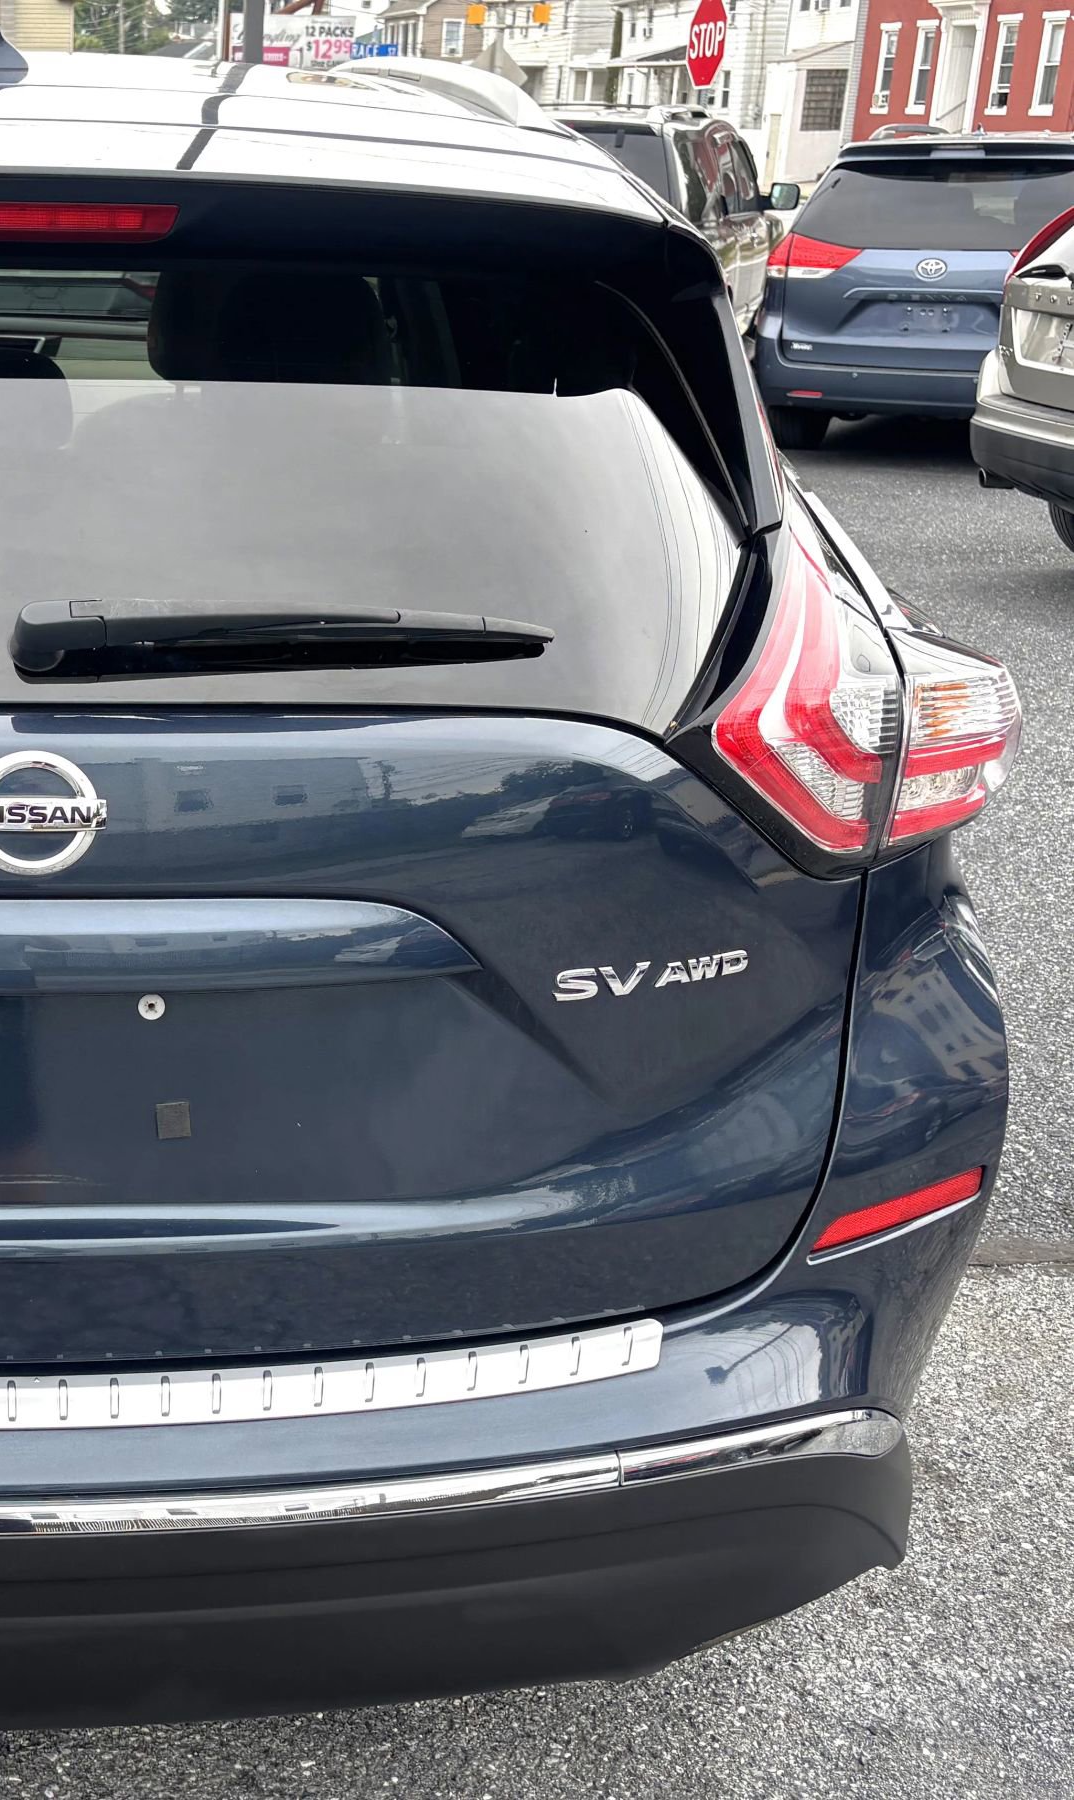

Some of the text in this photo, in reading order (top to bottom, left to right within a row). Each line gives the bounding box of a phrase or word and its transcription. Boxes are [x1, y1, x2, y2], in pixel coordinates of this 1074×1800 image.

[305, 25, 355, 38] 12 PACKS
[689, 21, 725, 60] STOP
[552, 949, 749, 1002] SV AWD
